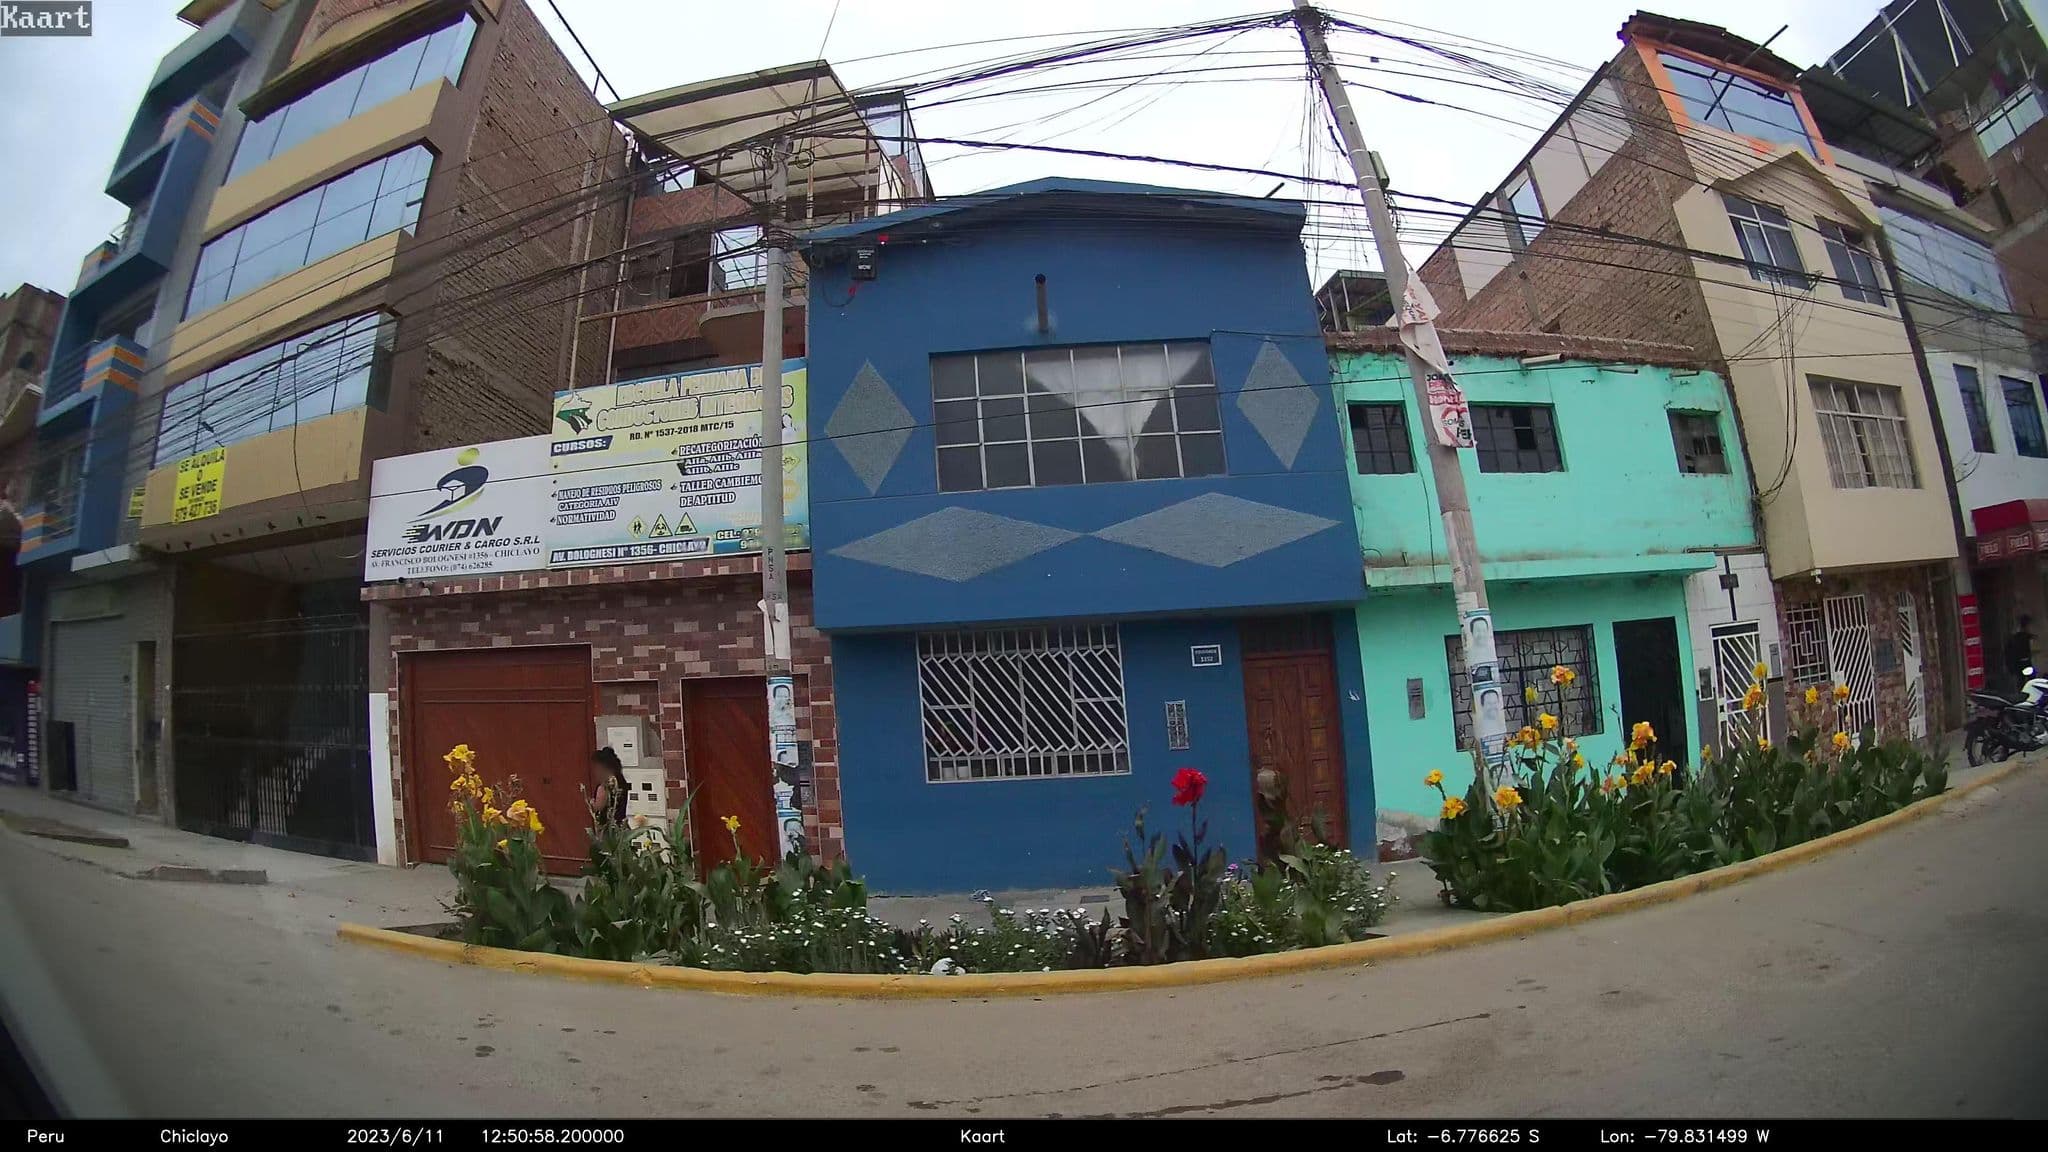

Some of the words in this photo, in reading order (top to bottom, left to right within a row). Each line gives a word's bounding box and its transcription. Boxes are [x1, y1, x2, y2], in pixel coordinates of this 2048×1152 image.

[617, 376, 680, 406] ESCUELA
[680, 368, 749, 397] PERUANA
[750, 366, 763, 388] D
[699, 385, 794, 419] INTEGRAS
[655, 425, 699, 438] 1537-2018
[700, 420, 735, 433] MTC/15
[553, 438, 607, 453] CURSOS:
[179, 460, 190, 474] SE
[191, 449, 225, 469] ALQUILA
[196, 469, 203, 482] O
[679, 479, 714, 493] TALLER
[179, 486, 190, 500] SE
[191, 479, 218, 497] VENDE
[557, 487, 581, 501] MANEJO
[581, 486, 591, 498] DE
[590, 483, 622, 498] RESIDUOS
[622, 479, 663, 495] PELIGROSOS
[679, 496, 693, 508] DE
[693, 491, 737, 506] APTITUD
[556, 510, 616, 525] NORMATIVIDAD
[401, 516, 503, 544] WDN
[371, 547, 417, 559] SERVICIOS
[419, 541, 462, 554] COURIER
[463, 540, 471, 550] &
[474, 537, 511, 550] CARGO
[513, 535, 541, 546] S.R.L
[381, 557, 422, 568] FRANCISCO
[422, 552, 468, 565] BOLOGNESI
[494, 547, 541, 559] CHICLAYO
[552, 551, 567, 563] AV.
[567, 547, 616, 561] BOLOGNESI
[658, 538, 707, 553] CHICLAYO
